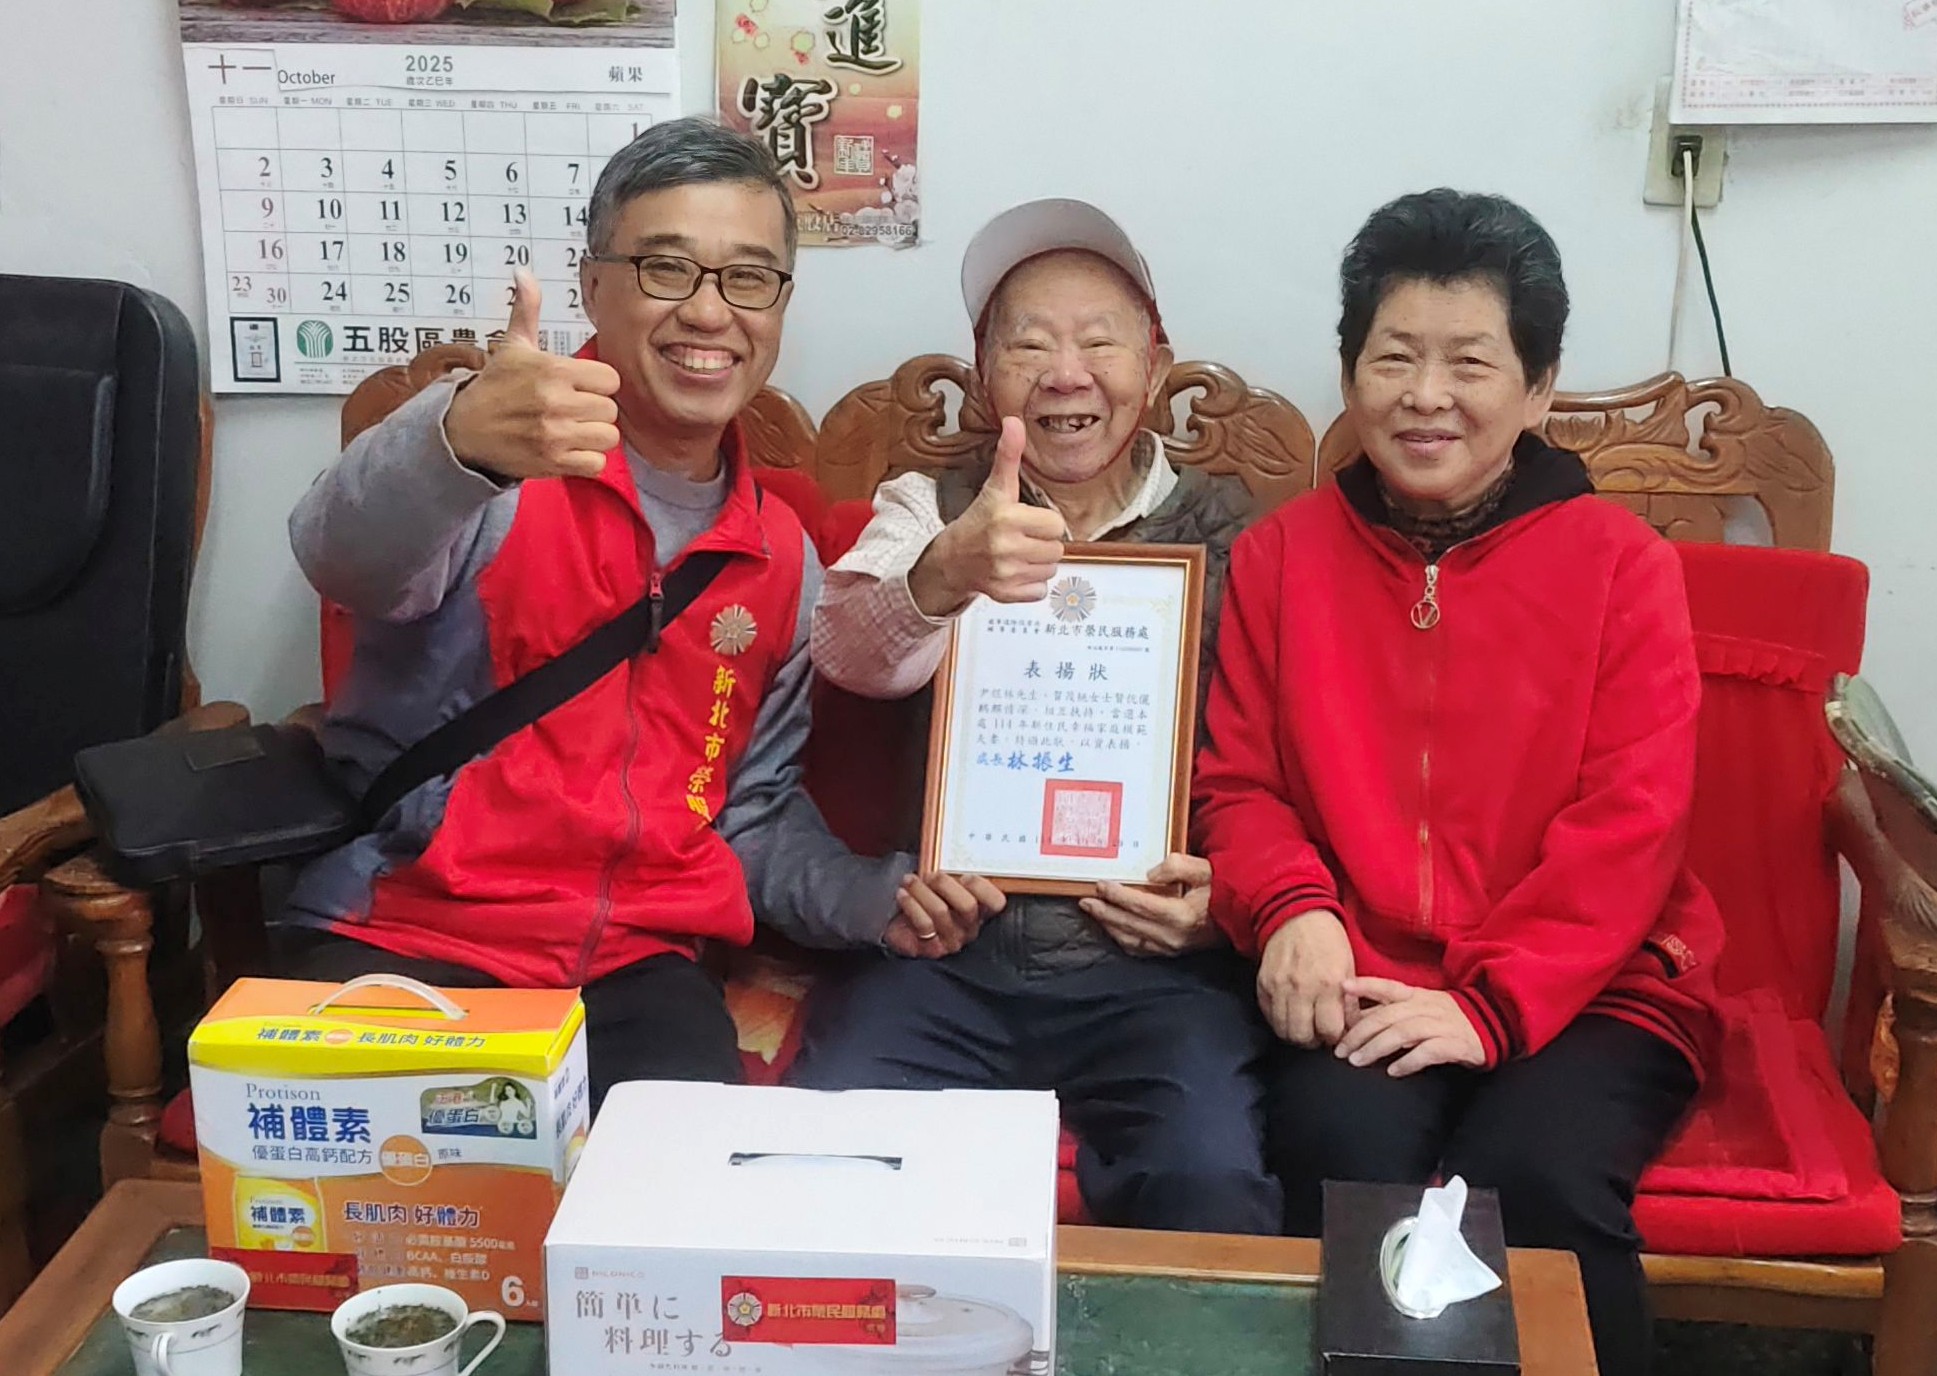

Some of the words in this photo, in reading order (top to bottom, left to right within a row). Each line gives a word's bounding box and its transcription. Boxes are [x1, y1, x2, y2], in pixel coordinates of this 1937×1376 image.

[207, 53, 272, 85] 十一
[405, 55, 454, 73] 2025
[608, 65, 643, 83] 蘋果
[277, 69, 336, 85] October
[311, 97, 333, 106] MON
[375, 98, 392, 107] TUE
[436, 99, 455, 108] WED
[500, 100, 518, 110] THU
[566, 102, 581, 110] FRI
[631, 122, 638, 140] 1
[258, 156, 271, 177] 2
[320, 157, 333, 178] 3
[381, 158, 394, 179] 4
[444, 160, 457, 181] 5
[506, 162, 519, 183] 6
[567, 163, 580, 184] 7
[261, 197, 274, 218] 9
[318, 199, 342, 219] 10
[380, 200, 400, 221] 11
[441, 201, 465, 222] 12
[503, 203, 527, 224] 13
[563, 206, 588, 226] 14
[259, 238, 284, 260] 16
[320, 240, 344, 261] 17
[382, 241, 406, 262] 18
[443, 243, 468, 264] 19
[504, 244, 530, 266] 20
[232, 276, 252, 292] 23
[321, 281, 347, 301] 24
[384, 282, 410, 303] 25
[445, 284, 471, 305] 26
[266, 287, 287, 304] 30
[506, 286, 518, 306] 2
[1045, 623, 1150, 640] 新北市榮民服務處
[1023, 659, 1110, 682] 表揚狀
[257, 1027, 323, 1042] 補體素
[357, 1031, 420, 1046] 長肌肉
[423, 1034, 487, 1049] 好體力
[246, 1082, 321, 1101] Protison
[247, 1102, 371, 1144] 補體素
[252, 1144, 374, 1165] 優蛋白高鈣配方
[250, 1205, 305, 1224] 補體素
[344, 1201, 408, 1224] 長肌肉
[414, 1204, 480, 1228] 好體力
[501, 1275, 525, 1307] 6
[604, 1325, 732, 1358] 料理する
